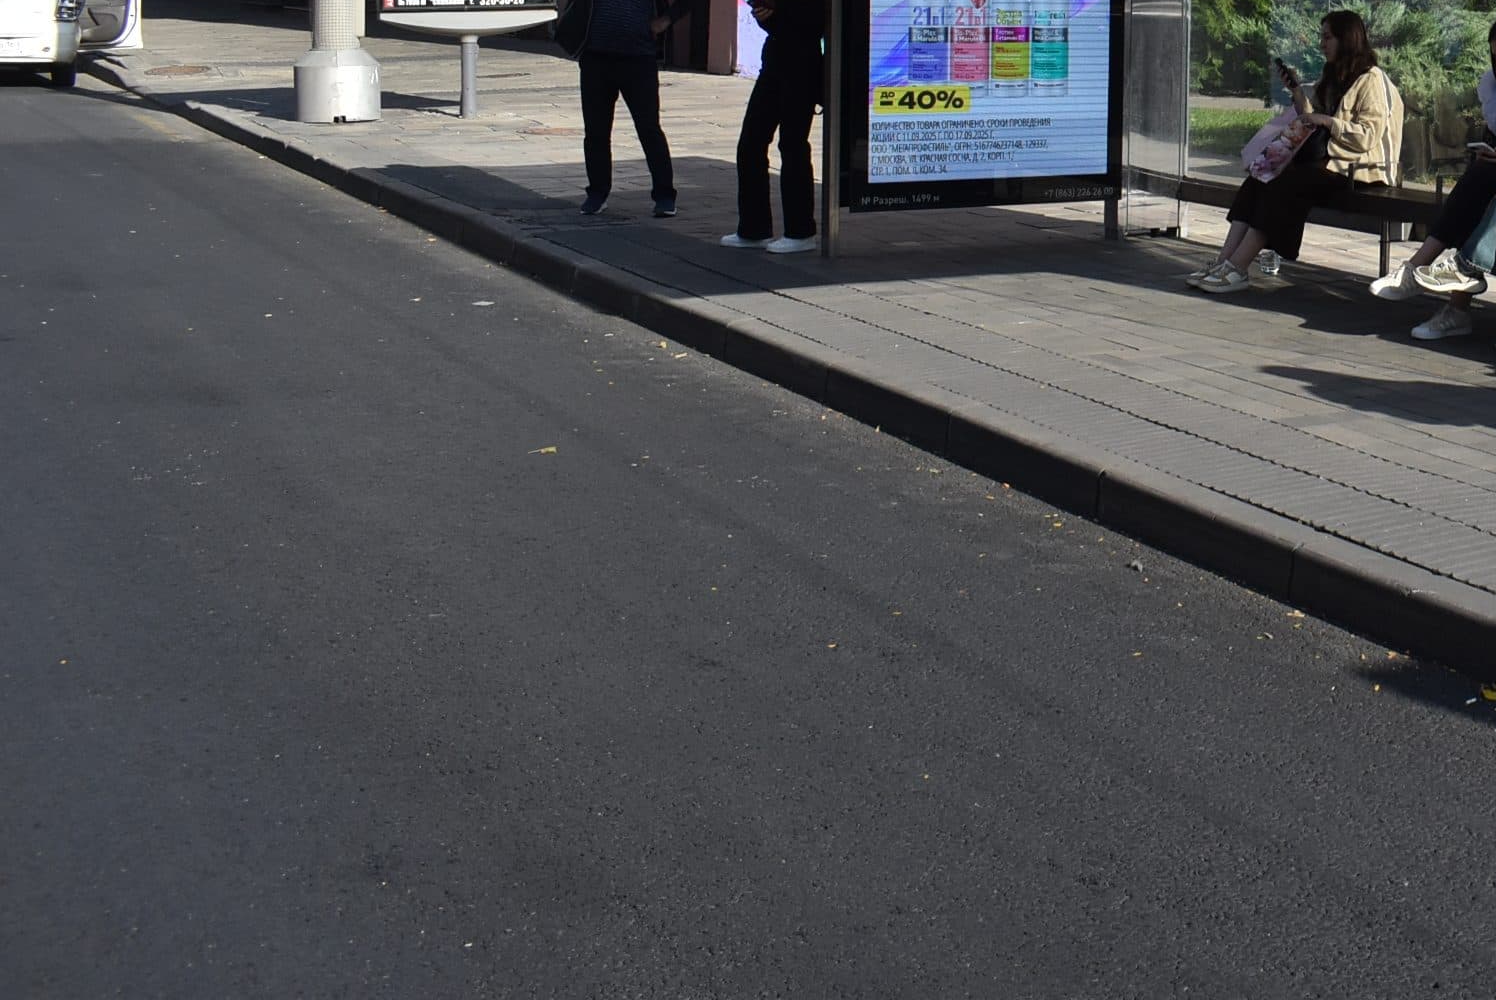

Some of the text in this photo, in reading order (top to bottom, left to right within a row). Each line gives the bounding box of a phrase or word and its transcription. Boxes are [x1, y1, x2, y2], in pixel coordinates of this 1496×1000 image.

[872, 121, 915, 130] КОЛИЧЕСТВО
[917, 121, 940, 130] ТОВАРА
[987, 119, 1008, 128] СРОКИ
[1011, 118, 1052, 127] ПРОВЕДЕНИЯ
[872, 133, 895, 142] АКЦИИ
[896, 132, 902, 141] С
[944, 131, 953, 140] ПО
[956, 130, 988, 139] 17.09.2025
[872, 144, 887, 154] ООО
[920, 153, 948, 163] КРАСНАЯ
[1044, 189, 1053, 197] +7
[1056, 188, 1075, 198] (863)
[873, 196, 909, 206] Разреш.
[912, 194, 931, 202] 1499
